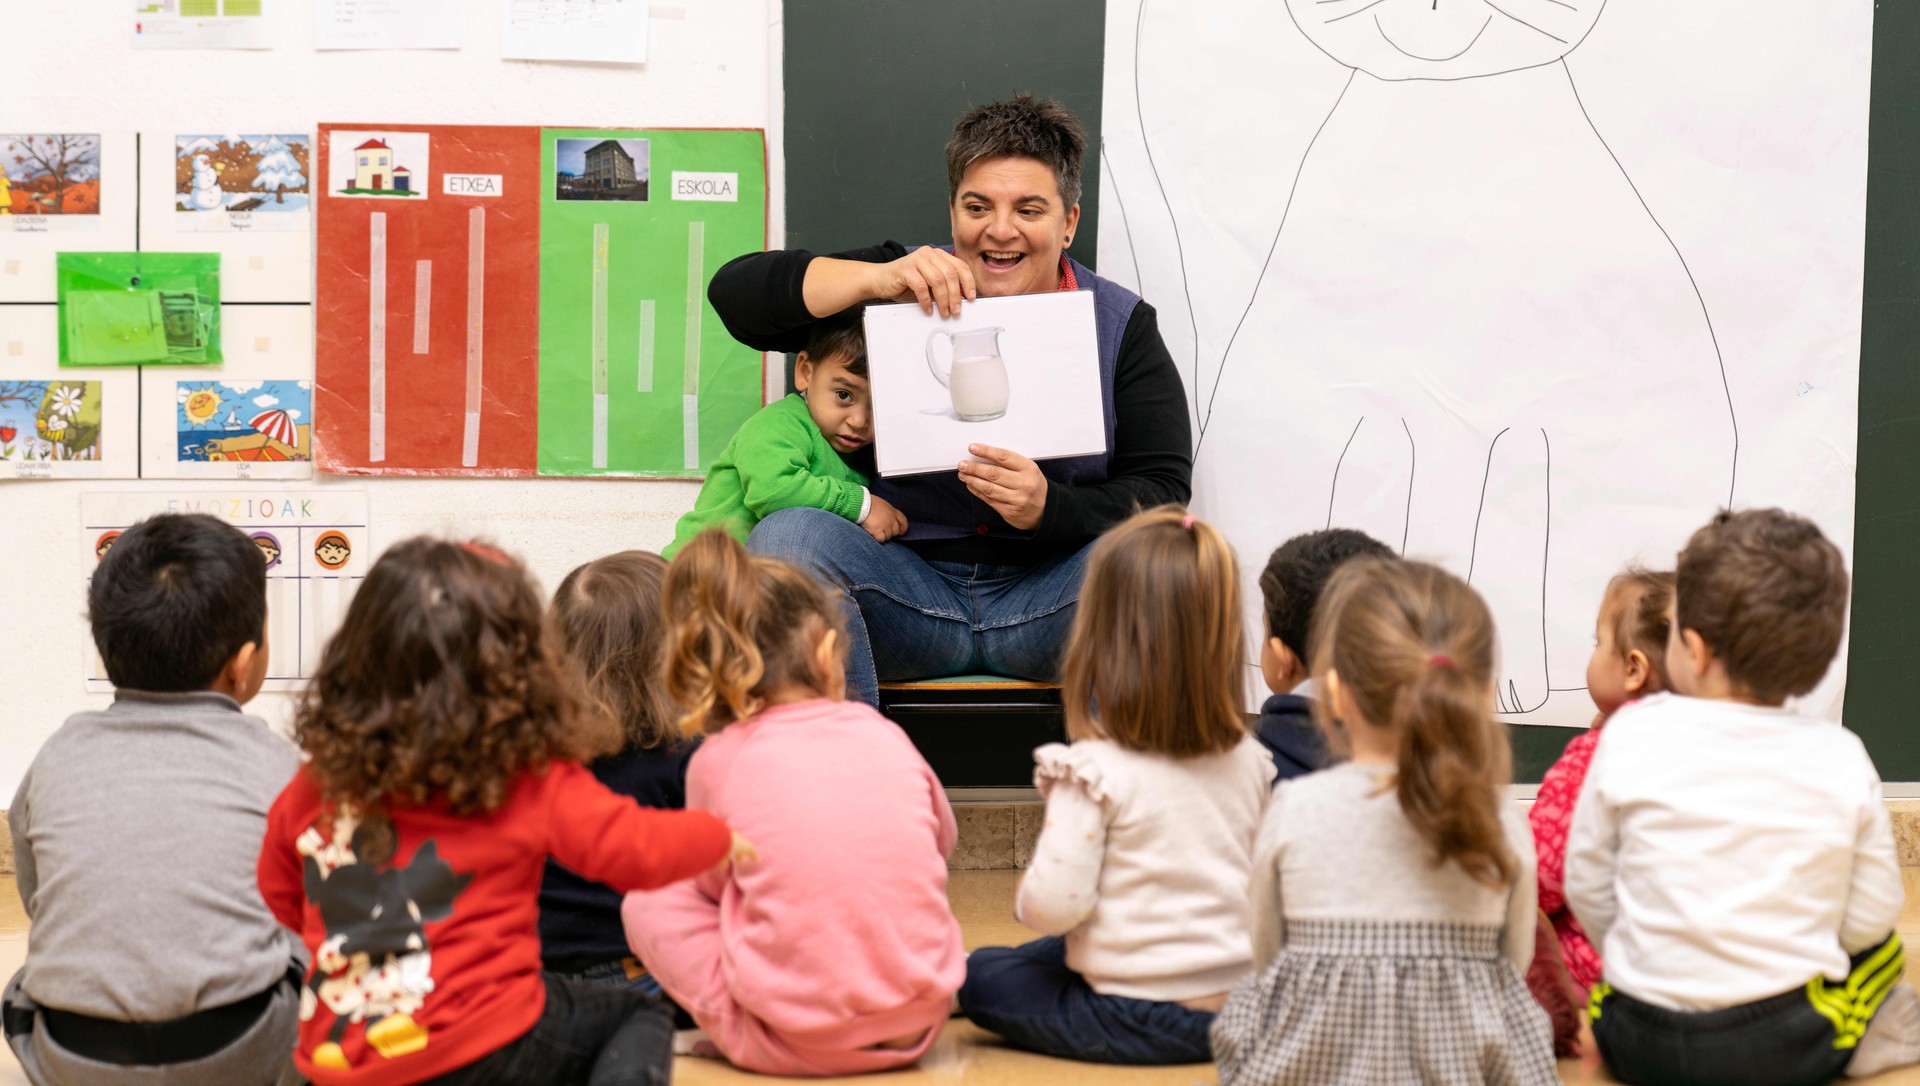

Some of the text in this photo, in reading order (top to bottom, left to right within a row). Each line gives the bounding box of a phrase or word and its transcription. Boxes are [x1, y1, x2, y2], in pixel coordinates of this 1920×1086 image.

[450, 176, 496, 193] ETXEA
[678, 179, 732, 196] ESKOLA
[168, 499, 312, 518] EMOZIOAK
